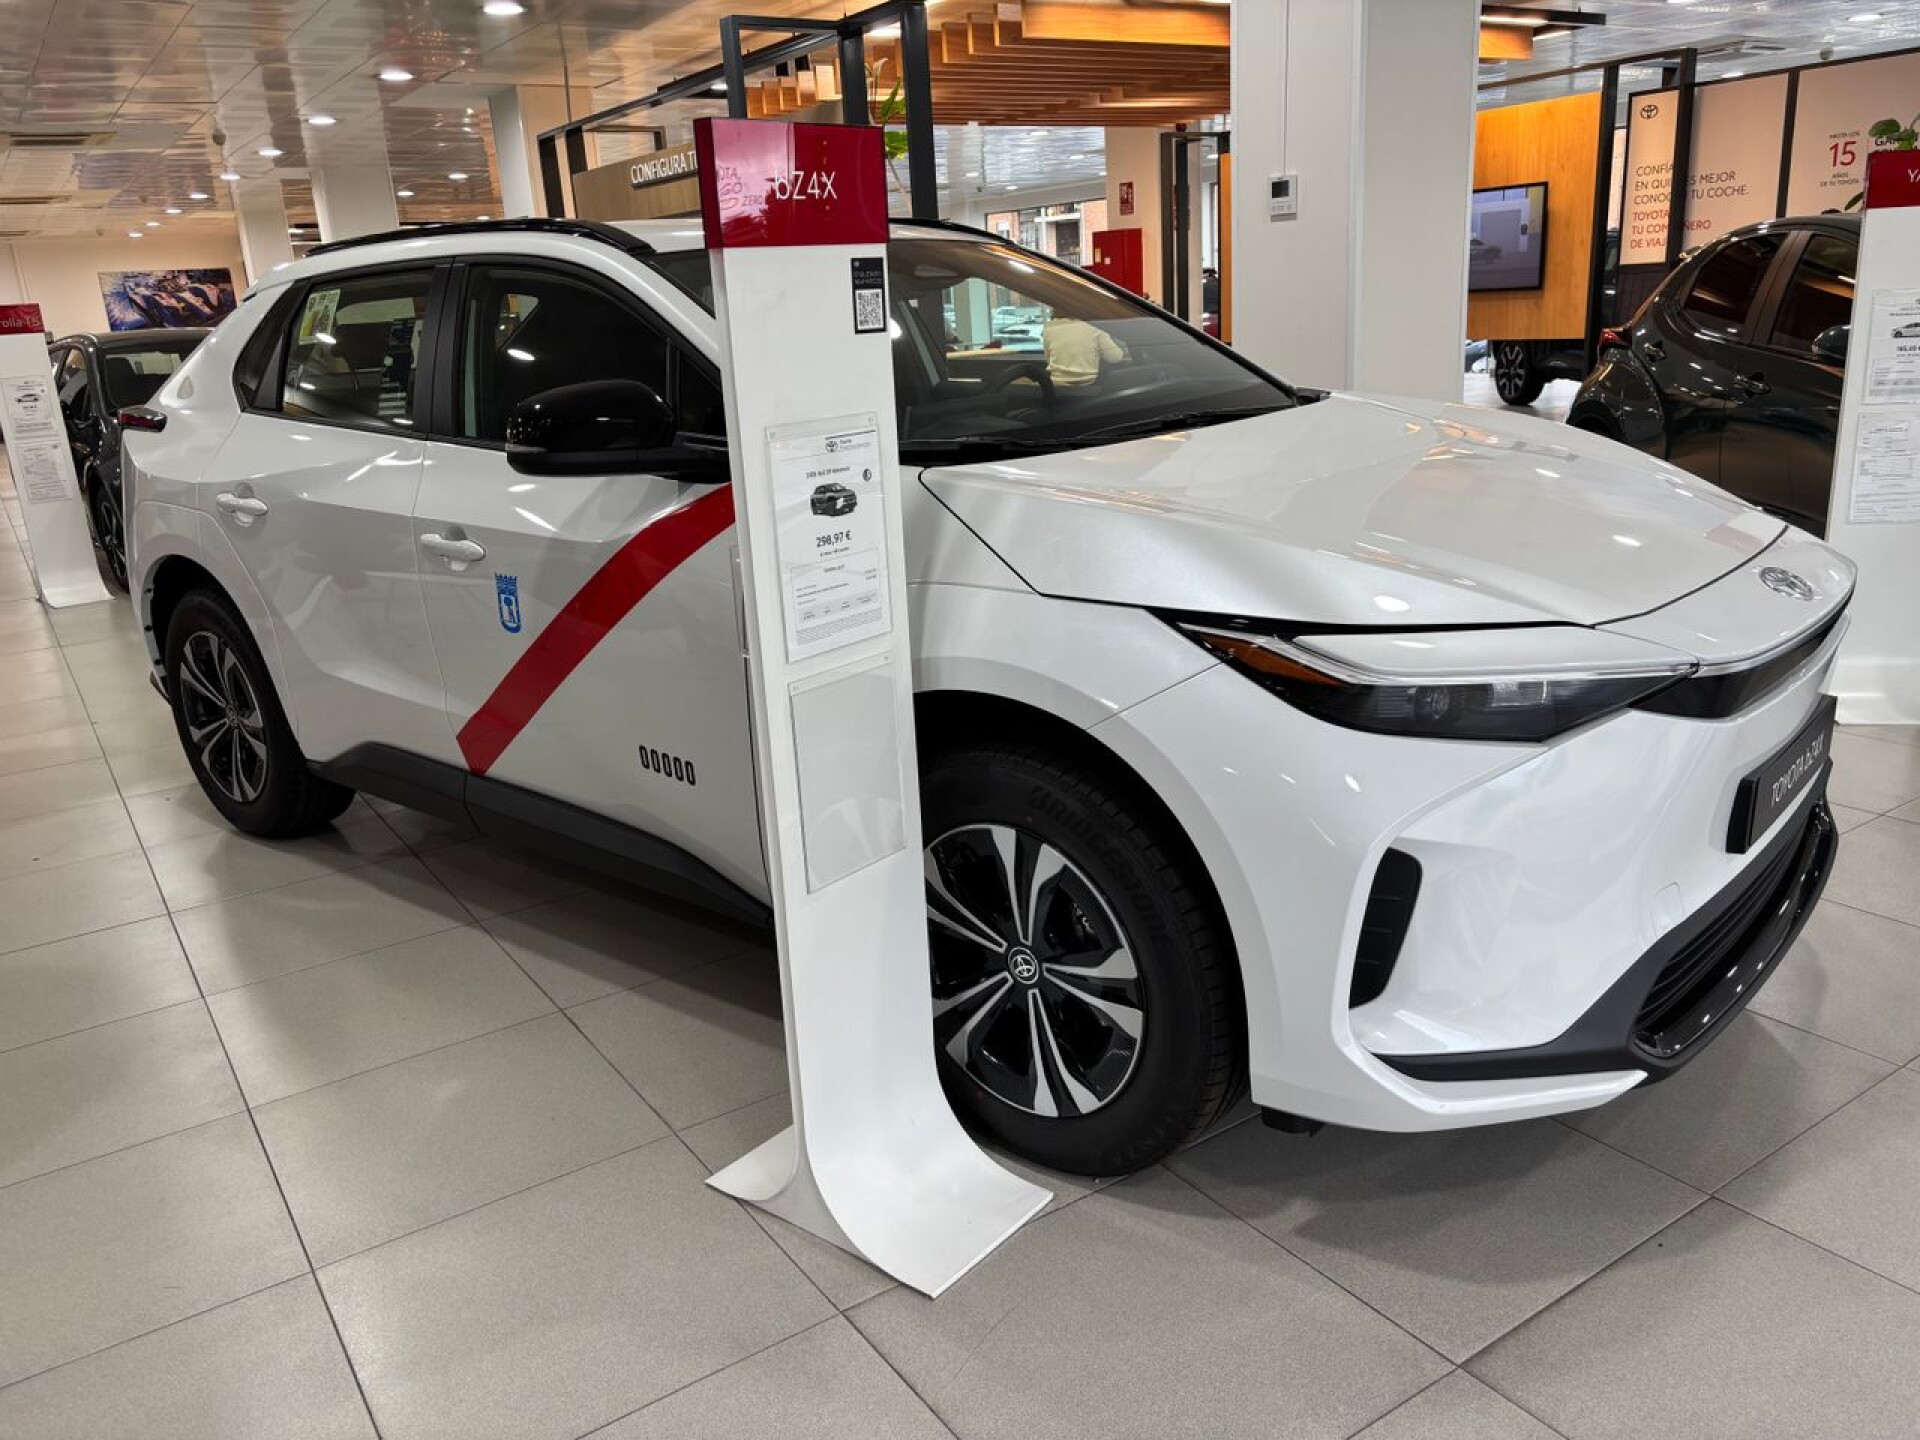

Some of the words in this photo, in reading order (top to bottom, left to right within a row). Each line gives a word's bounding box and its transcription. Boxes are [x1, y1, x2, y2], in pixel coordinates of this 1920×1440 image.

[1829, 140, 1857, 168] 15
[630, 153, 689, 184] CONFIGURA
[773, 169, 838, 200] bZ4X
[1634, 180, 1648, 191] EN
[1699, 170, 1737, 185] MEJOR
[1691, 188, 1704, 200] TU
[1631, 225, 1644, 235] TU
[1630, 238, 1643, 250] DE
[1646, 236, 1666, 249] VIAJ
[845, 529, 853, 541] €
[1770, 755, 1804, 808] TOYOTA
